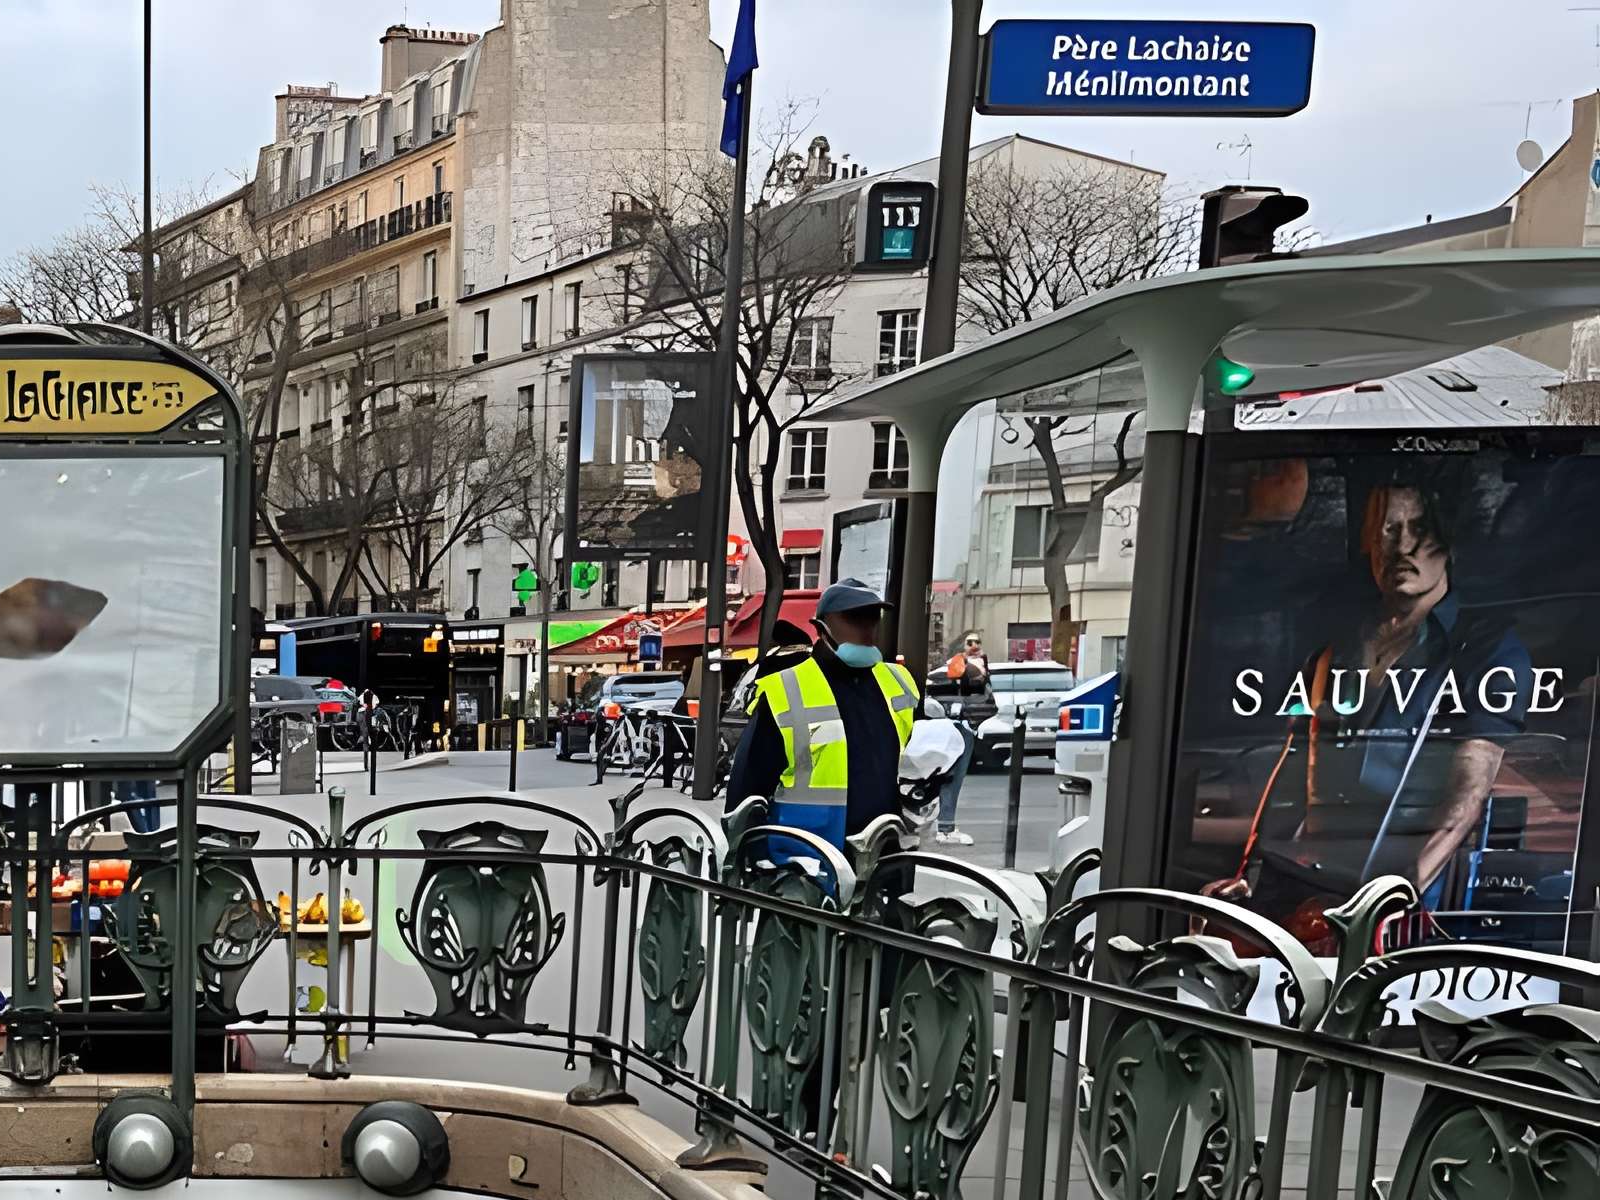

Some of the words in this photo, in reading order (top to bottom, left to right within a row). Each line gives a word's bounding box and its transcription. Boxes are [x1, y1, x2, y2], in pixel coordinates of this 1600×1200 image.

[1052, 35, 1117, 60] Père
[1128, 35, 1250, 61] Lachaise
[1232, 667, 1565, 716] SAUVAGE
[1410, 966, 1530, 1001] DIOR
